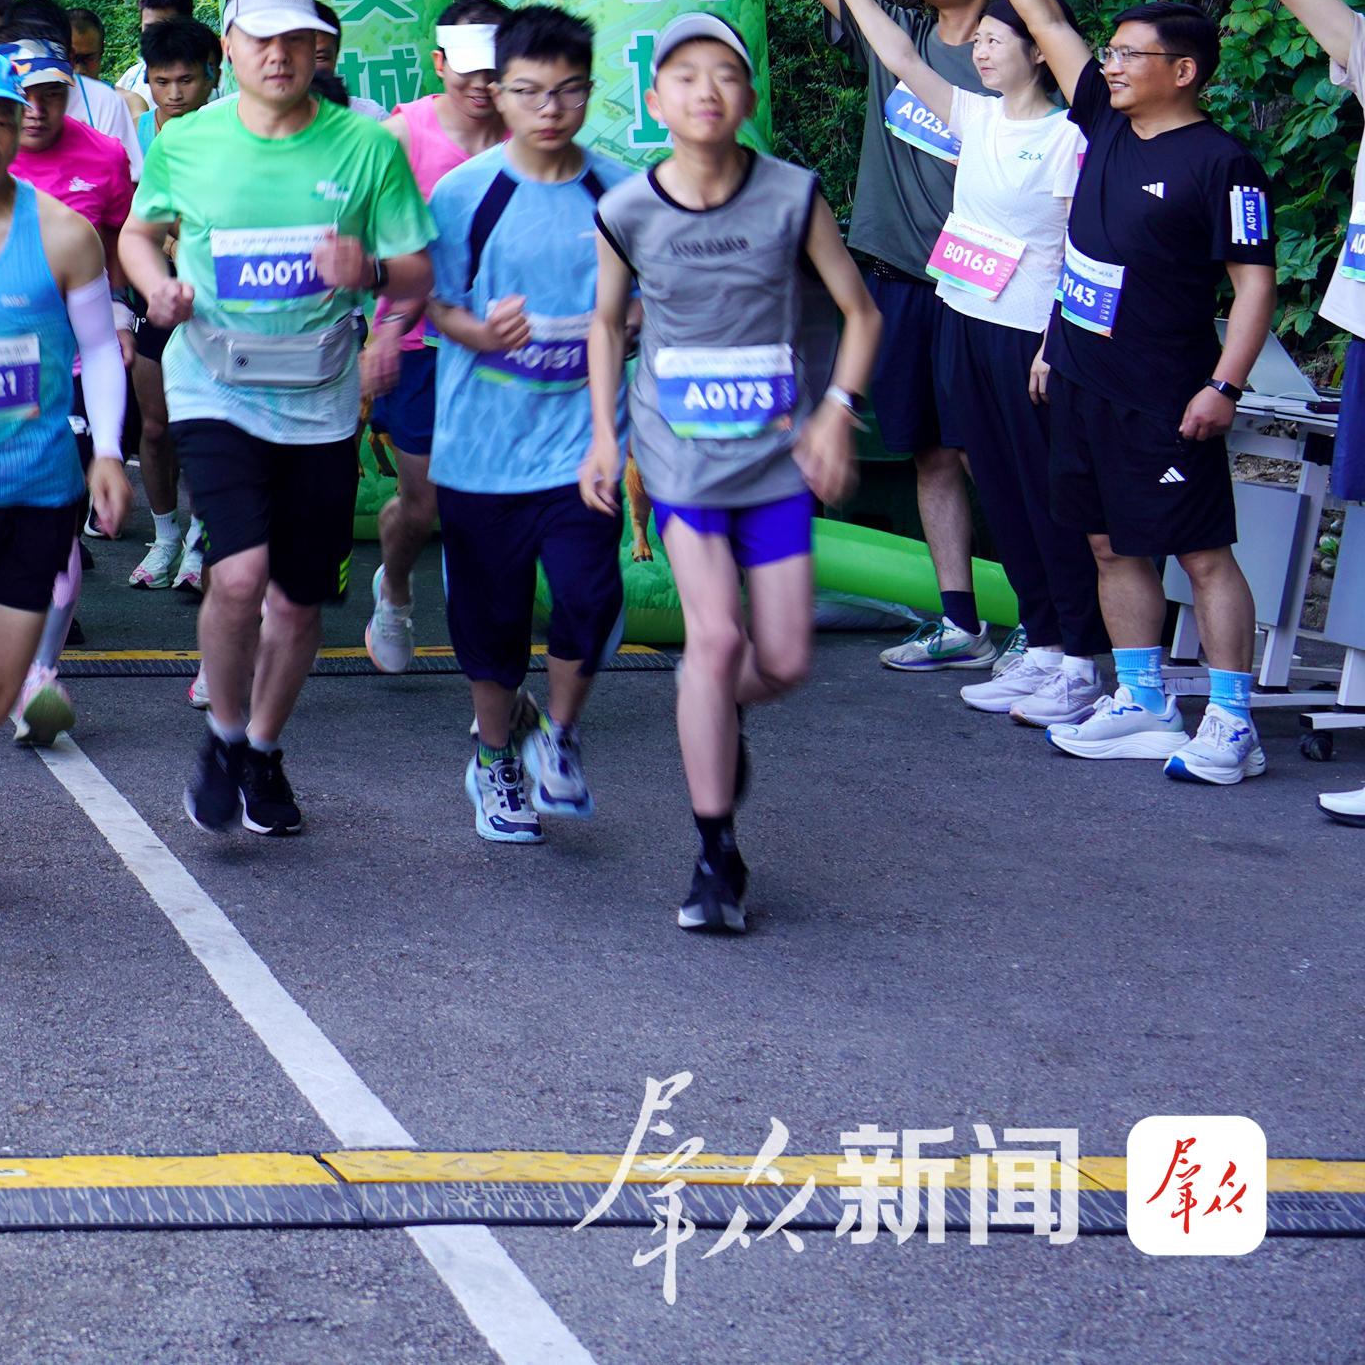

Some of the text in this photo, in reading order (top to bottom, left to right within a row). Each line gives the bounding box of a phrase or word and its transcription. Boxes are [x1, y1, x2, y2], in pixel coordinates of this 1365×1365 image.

[1245, 200, 1257, 231] A0143
[942, 240, 998, 276] B0168
[683, 381, 775, 410] A0173
